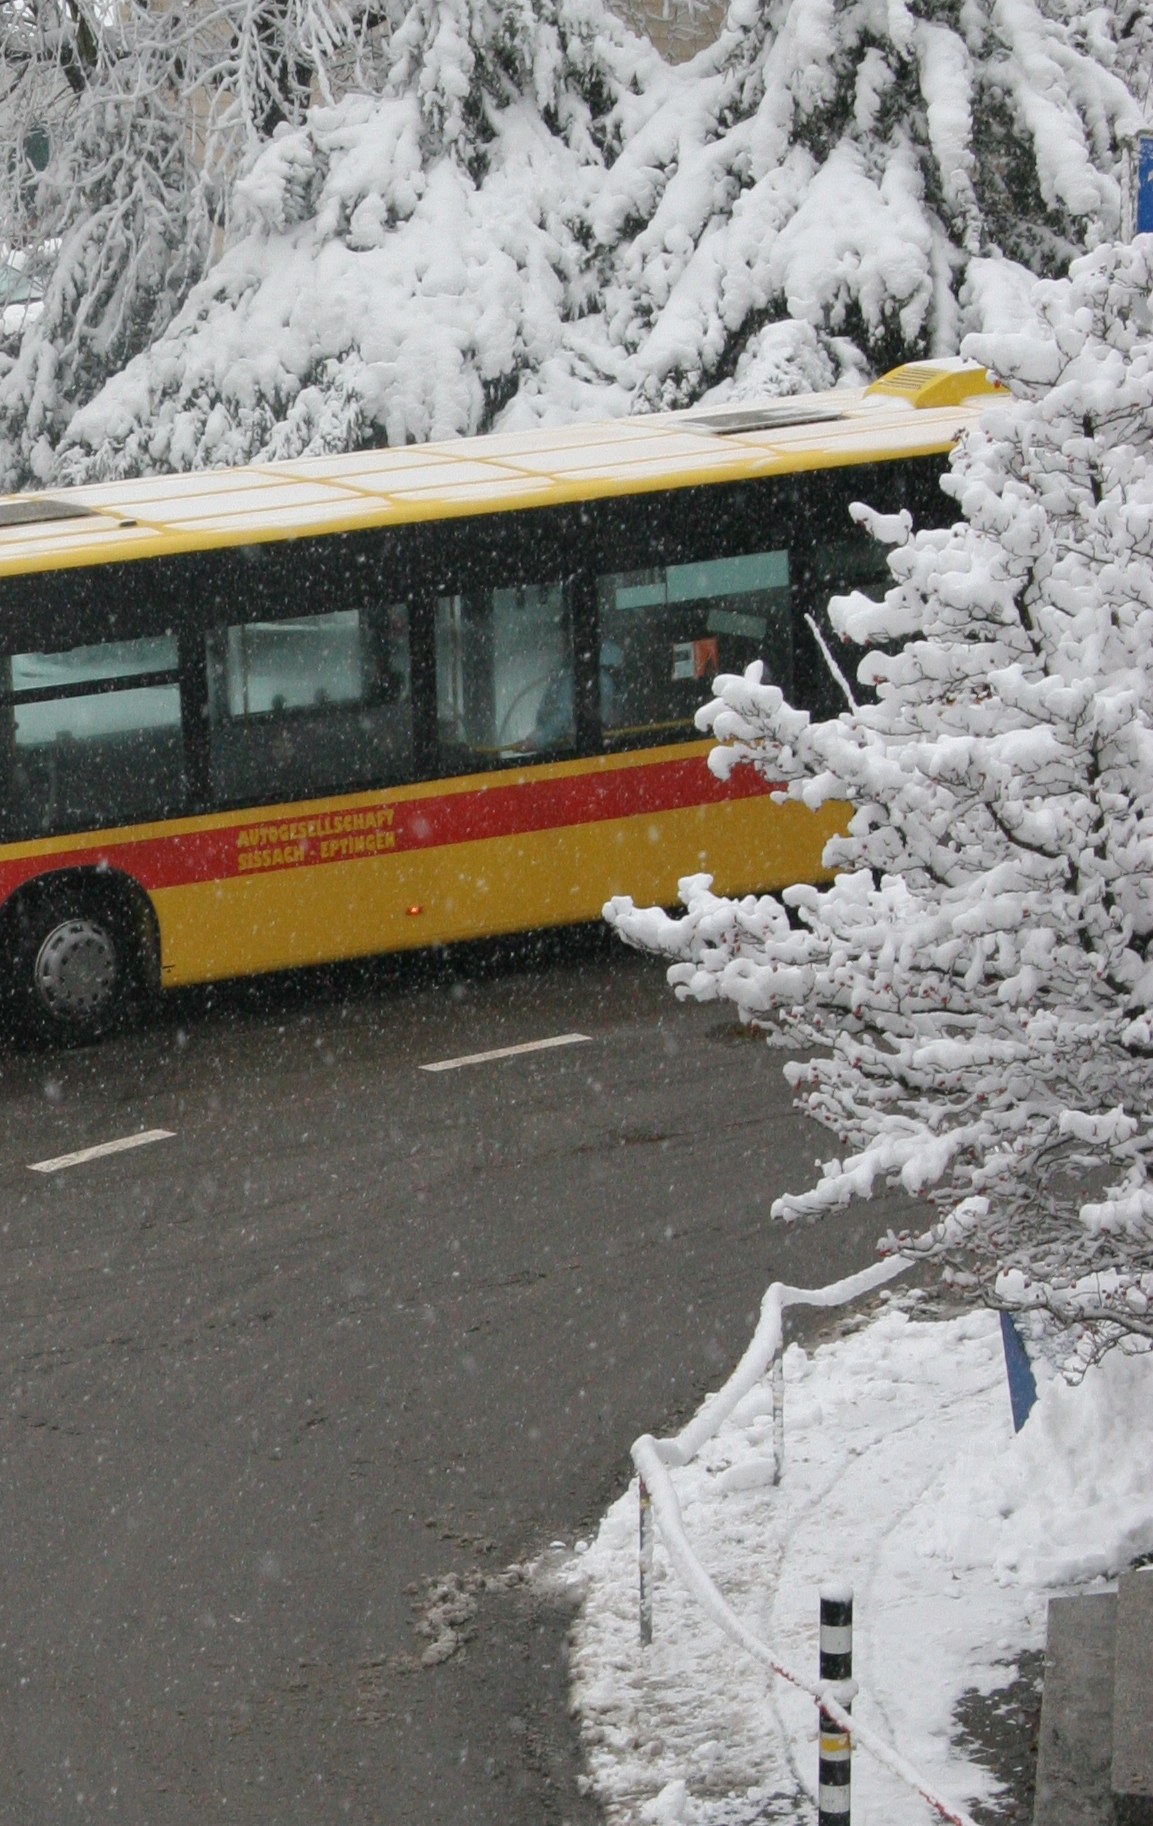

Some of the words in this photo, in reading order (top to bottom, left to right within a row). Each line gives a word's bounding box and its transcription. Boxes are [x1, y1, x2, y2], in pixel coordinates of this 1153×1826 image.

[237, 809, 395, 848] AUTOGESELLSCHAFT
[238, 845, 305, 870] SISSACH
[320, 831, 396, 858] EPTINGEN
